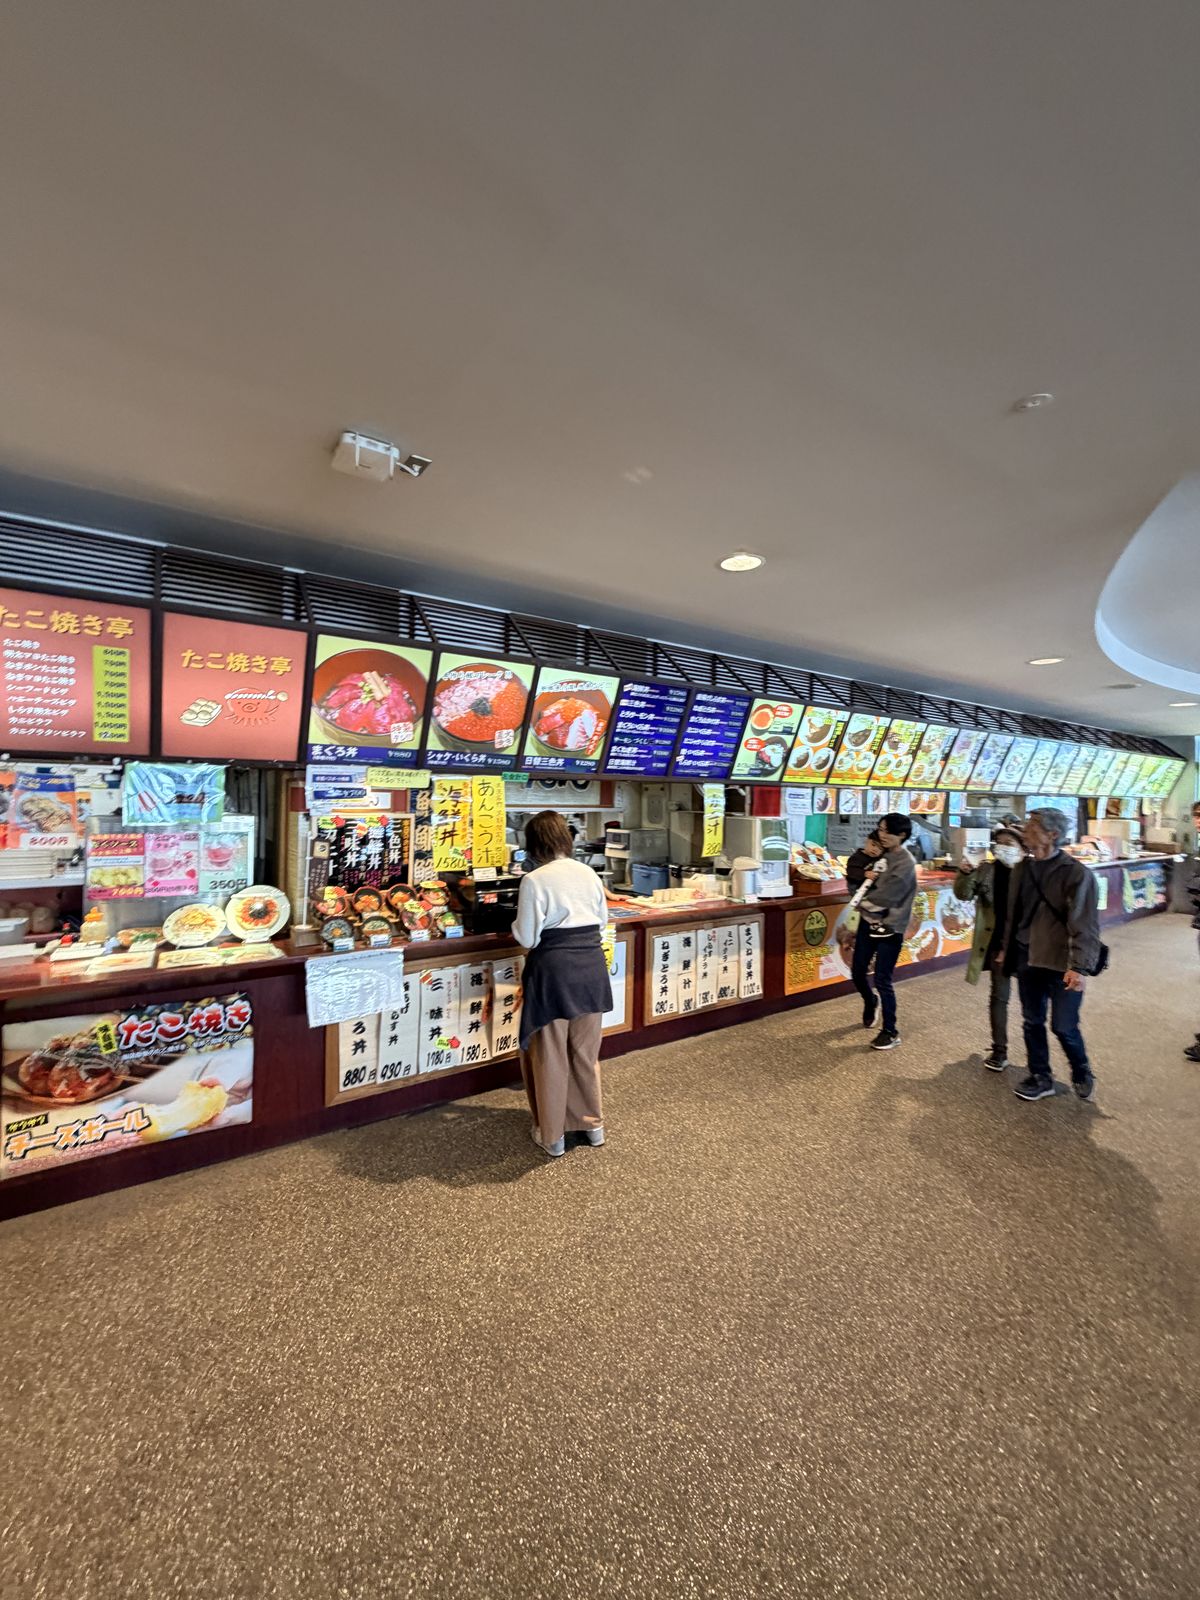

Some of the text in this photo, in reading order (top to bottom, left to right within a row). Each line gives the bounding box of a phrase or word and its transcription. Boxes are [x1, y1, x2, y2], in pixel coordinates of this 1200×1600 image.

[0, 605, 135, 639] たこ焼き亭
[180, 649, 292, 676] たこ焼き亭
[311, 745, 358, 758] まぐろ丼
[427, 751, 487, 763] シャケ・いくら丼
[525, 757, 565, 767] 日替三色丼
[477, 778, 495, 864] あんこう汁
[659, 941, 670, 996] ねぎとろ丼
[429, 977, 444, 1041] 三味丼
[467, 973, 484, 1034] 海鮮丼
[501, 967, 514, 1026] 三色丼
[119, 999, 252, 1050] たこ焼き
[381, 1061, 411, 1081] 930円
[5, 1107, 152, 1159] チーズボール
